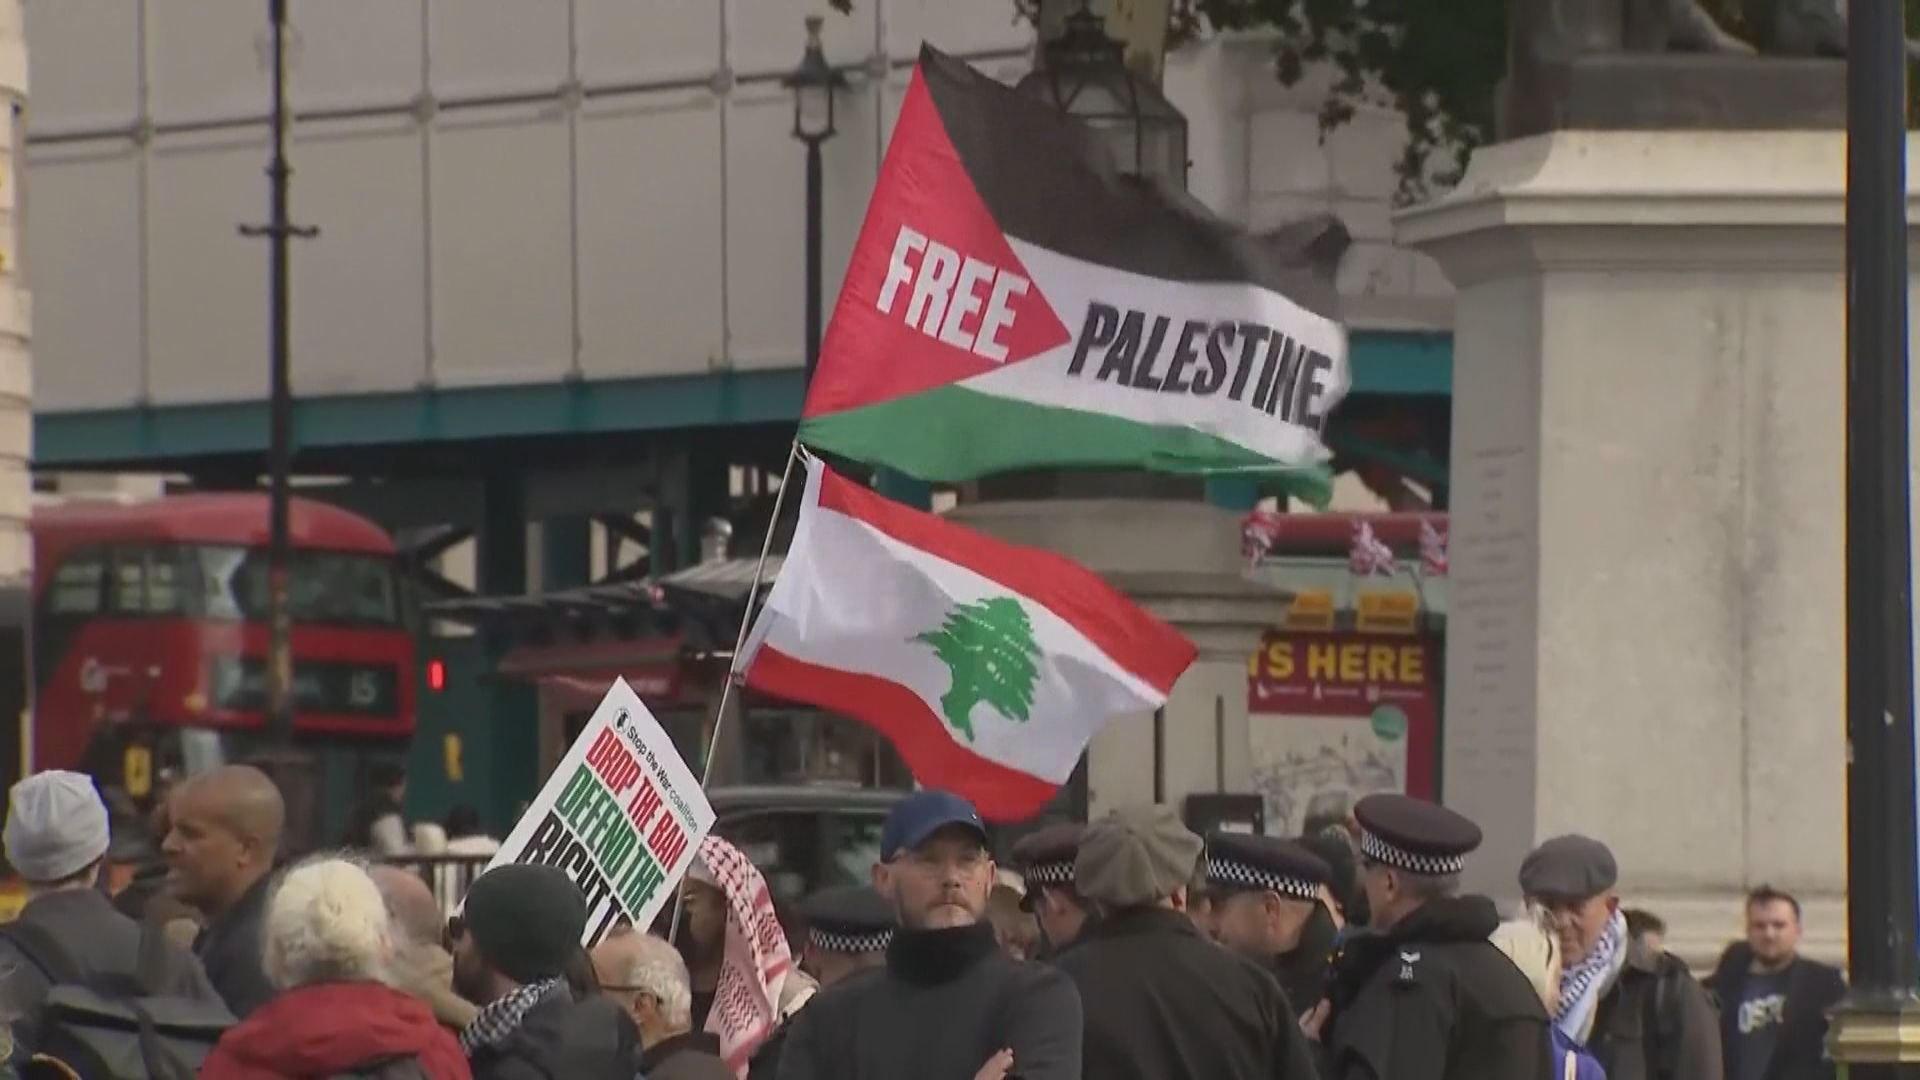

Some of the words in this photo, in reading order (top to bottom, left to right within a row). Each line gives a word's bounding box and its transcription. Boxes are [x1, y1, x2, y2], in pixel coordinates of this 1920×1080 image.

[876, 224, 1029, 364] FREE
[1067, 300, 1333, 429] PALESTINE
[350, 670, 377, 705] 15
[1307, 641, 1425, 684] HERE
[586, 726, 643, 798] DROP
[627, 776, 664, 832] THE
[647, 810, 690, 875] BAN
[626, 726, 648, 756] Stop
[644, 748, 660, 772] the
[655, 765, 673, 792] War
[668, 788, 699, 832] coalition
[554, 762, 638, 880] DEFEND
[616, 841, 666, 922] THE
[586, 894, 632, 949] T
